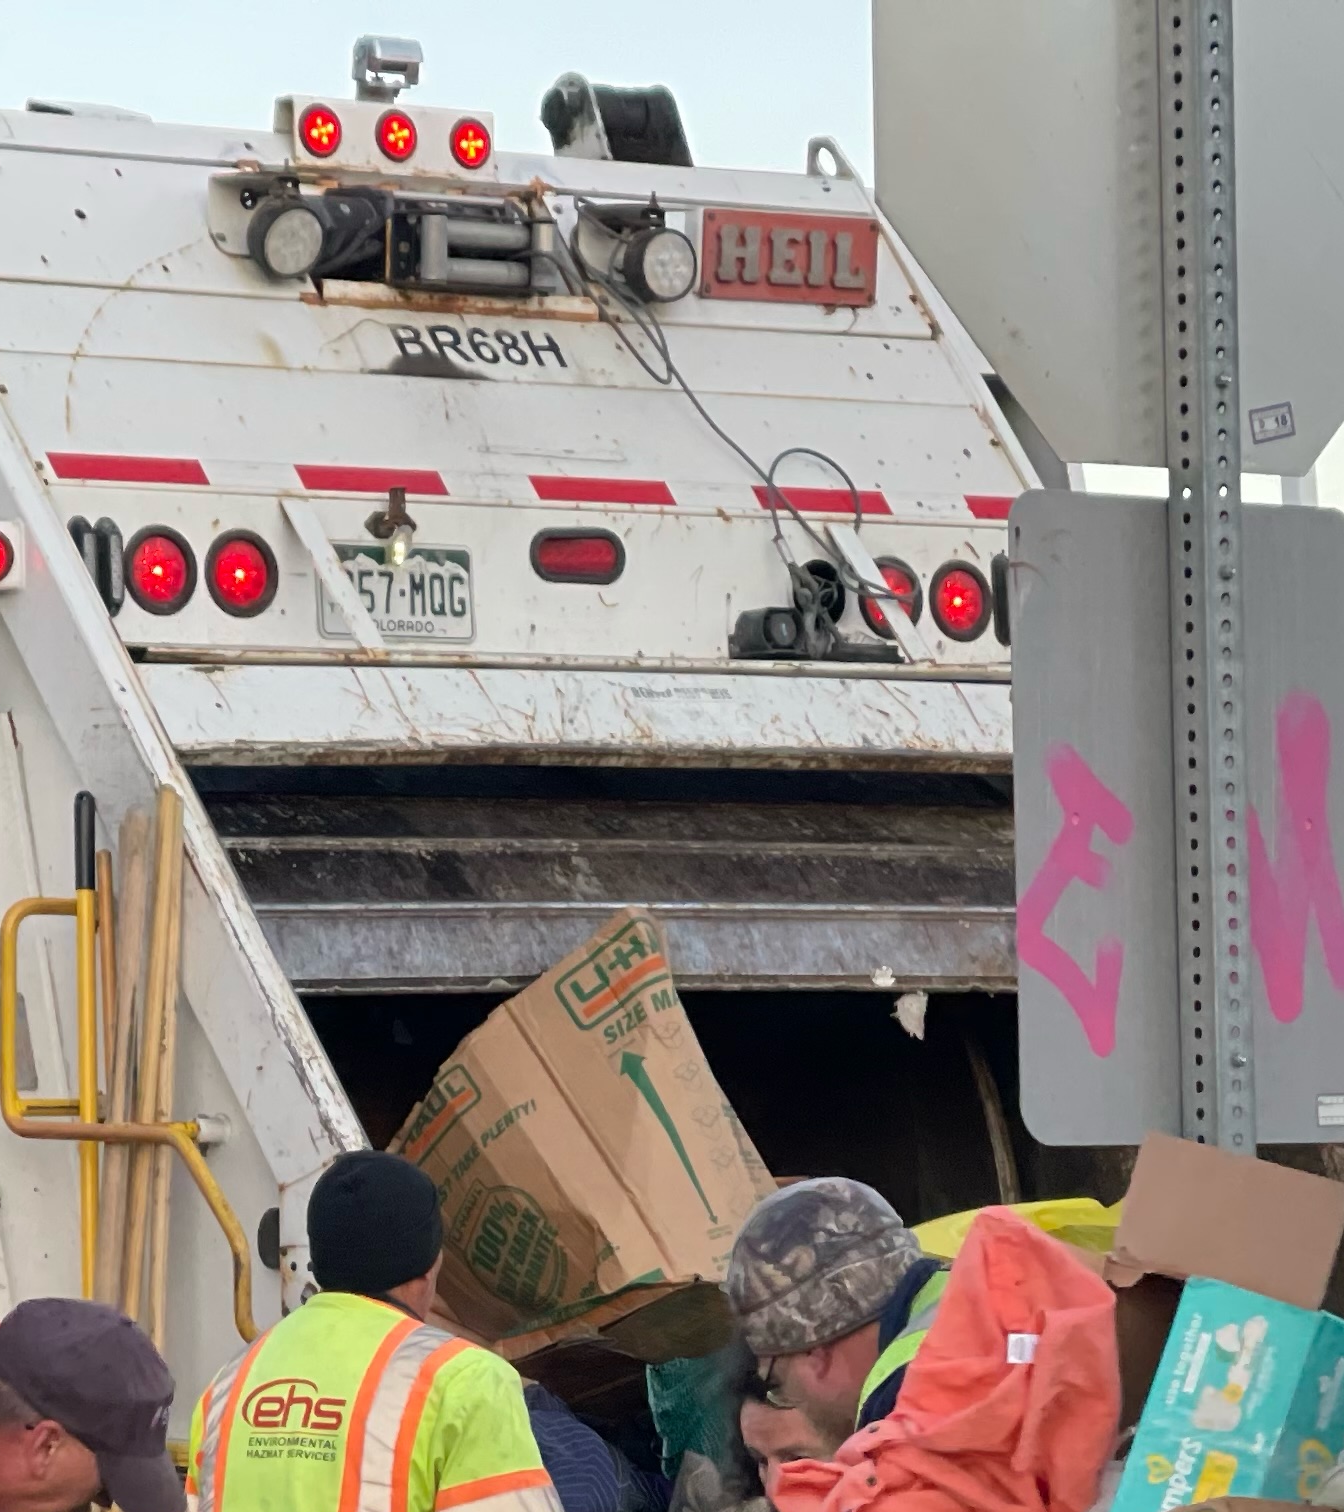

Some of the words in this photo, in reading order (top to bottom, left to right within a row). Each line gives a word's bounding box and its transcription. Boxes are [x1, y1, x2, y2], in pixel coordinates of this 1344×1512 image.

[715, 223, 866, 290] HEIL
[389, 323, 568, 369] BR68H
[603, 1002, 648, 1045] SIZE
[451, 1142, 481, 1181] TAKE
[479, 1098, 538, 1149] PLENTY!
[471, 1195, 519, 1274] 100%
[1174, 1312, 1203, 1384] together
[252, 1384, 347, 1431] ehs
